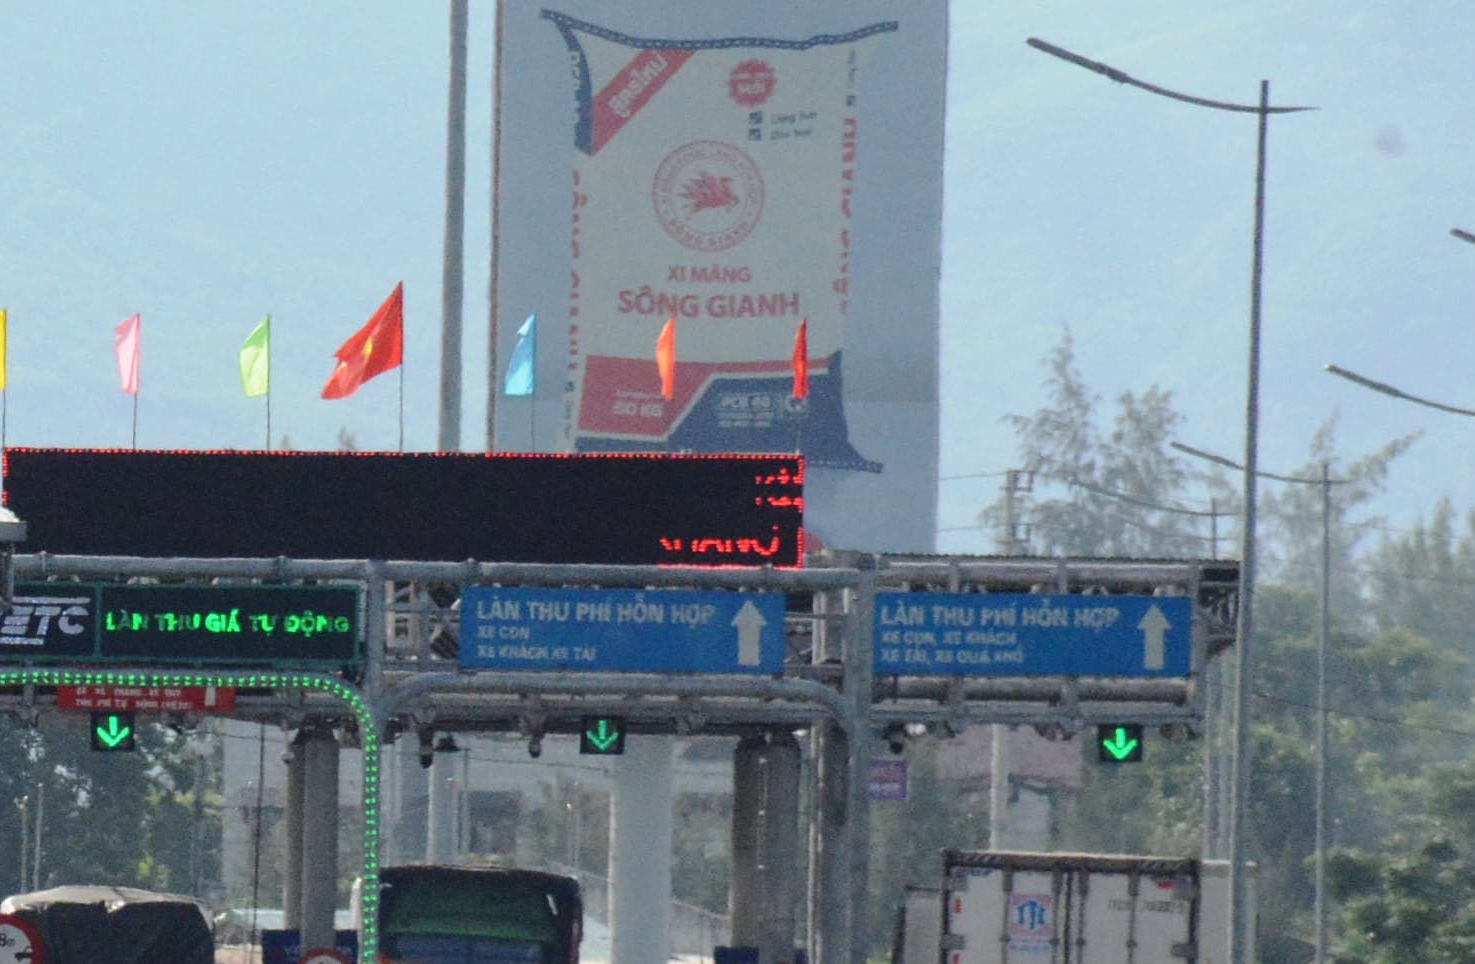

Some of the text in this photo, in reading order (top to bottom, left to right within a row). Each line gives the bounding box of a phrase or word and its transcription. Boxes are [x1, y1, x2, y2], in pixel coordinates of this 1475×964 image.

[668, 262, 751, 282] XI MĂNG
[618, 284, 799, 319] SÔNG GIANH
[105, 610, 148, 631] LÀN
[156, 611, 201, 632] THU
[205, 608, 240, 633] GIÁ
[284, 611, 349, 638] ĐỘNG
[478, 592, 717, 629] LÀN THU PHÍ HỖN HỢP
[881, 597, 1120, 632] LÀN THU PHÍ HỖN HỢP
